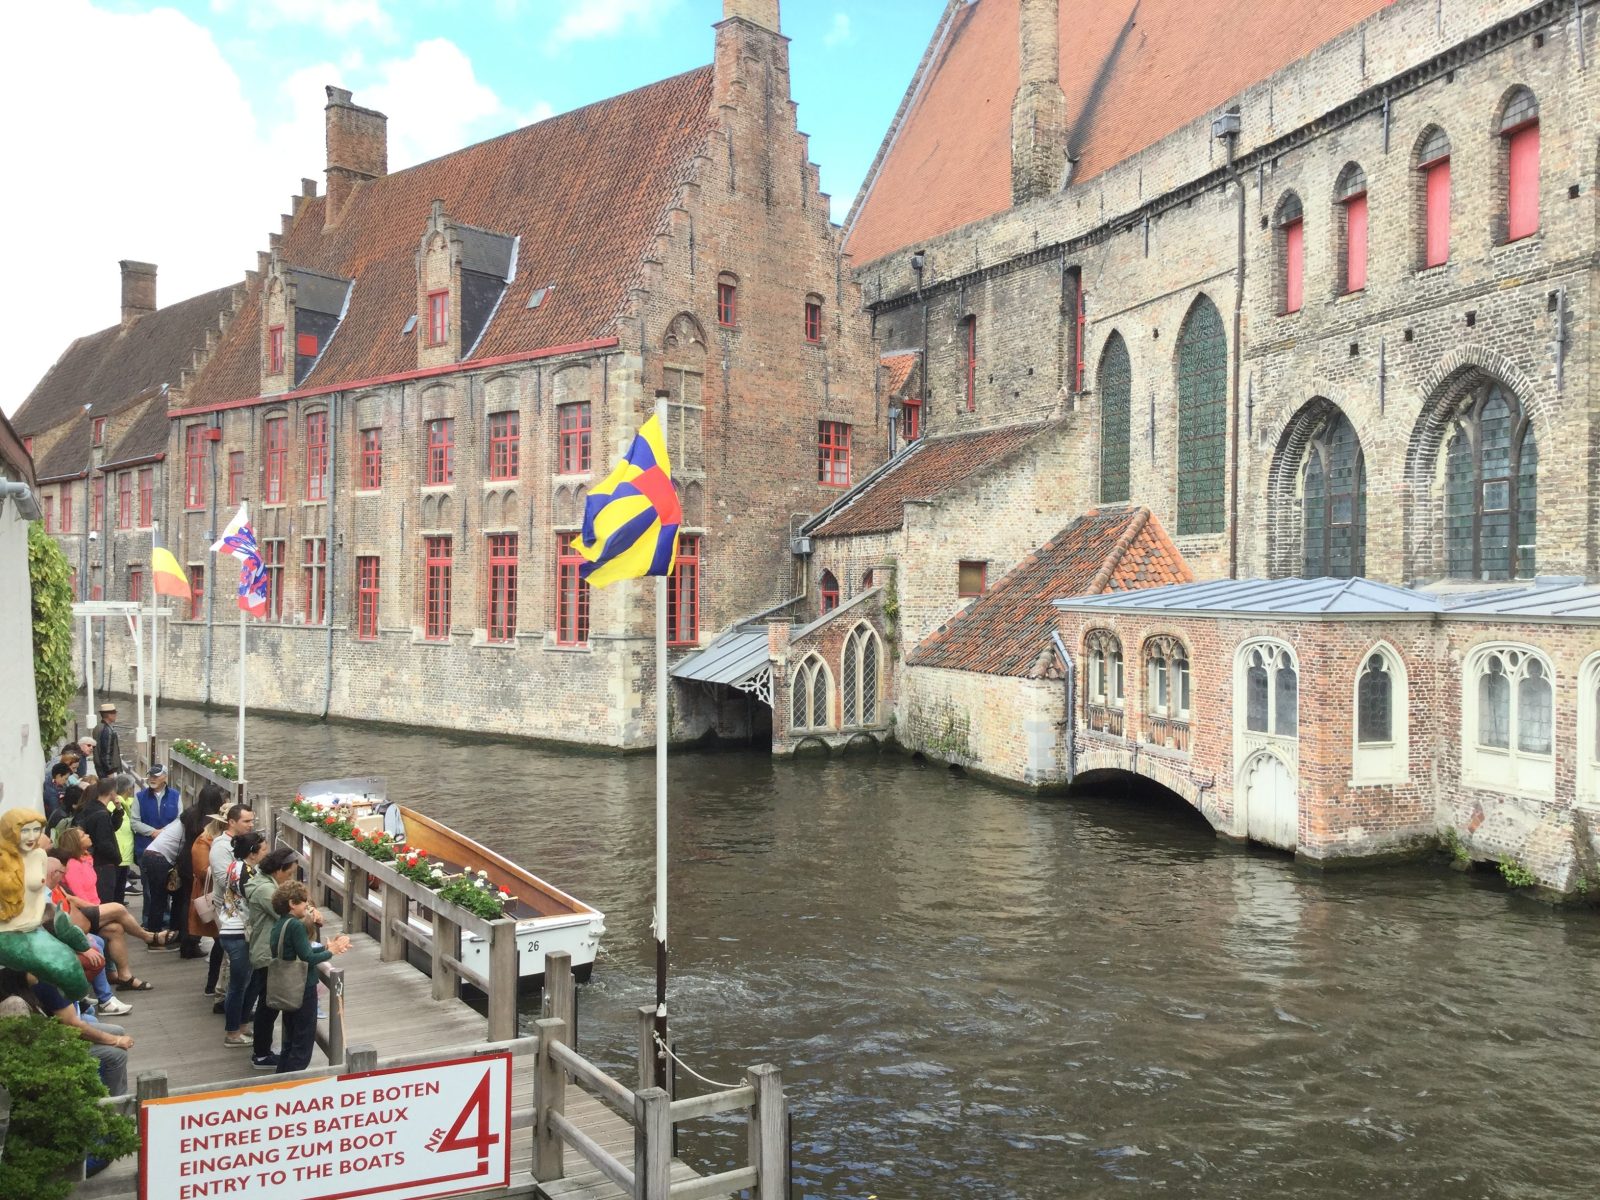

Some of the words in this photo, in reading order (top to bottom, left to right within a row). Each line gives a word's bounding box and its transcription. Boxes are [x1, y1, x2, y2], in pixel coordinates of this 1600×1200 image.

[527, 940, 540, 953] 26
[180, 1104, 268, 1131] INGANG
[275, 1096, 334, 1117] NAAR
[340, 1091, 366, 1108] DE
[372, 1080, 440, 1104] BOTEN
[424, 1126, 448, 1152] NR
[436, 1067, 500, 1159] 4
[180, 1127, 262, 1154] ENTREE
[268, 1121, 307, 1141] DES
[313, 1106, 409, 1135] BATEAUX
[180, 1148, 281, 1177] EINGANG
[286, 1140, 334, 1161] ZUM
[339, 1130, 398, 1153] BOOT
[180, 1175, 252, 1200] ENTRY
[256, 1170, 287, 1187] TO
[292, 1163, 334, 1183] THE
[339, 1151, 406, 1175] BOATS
